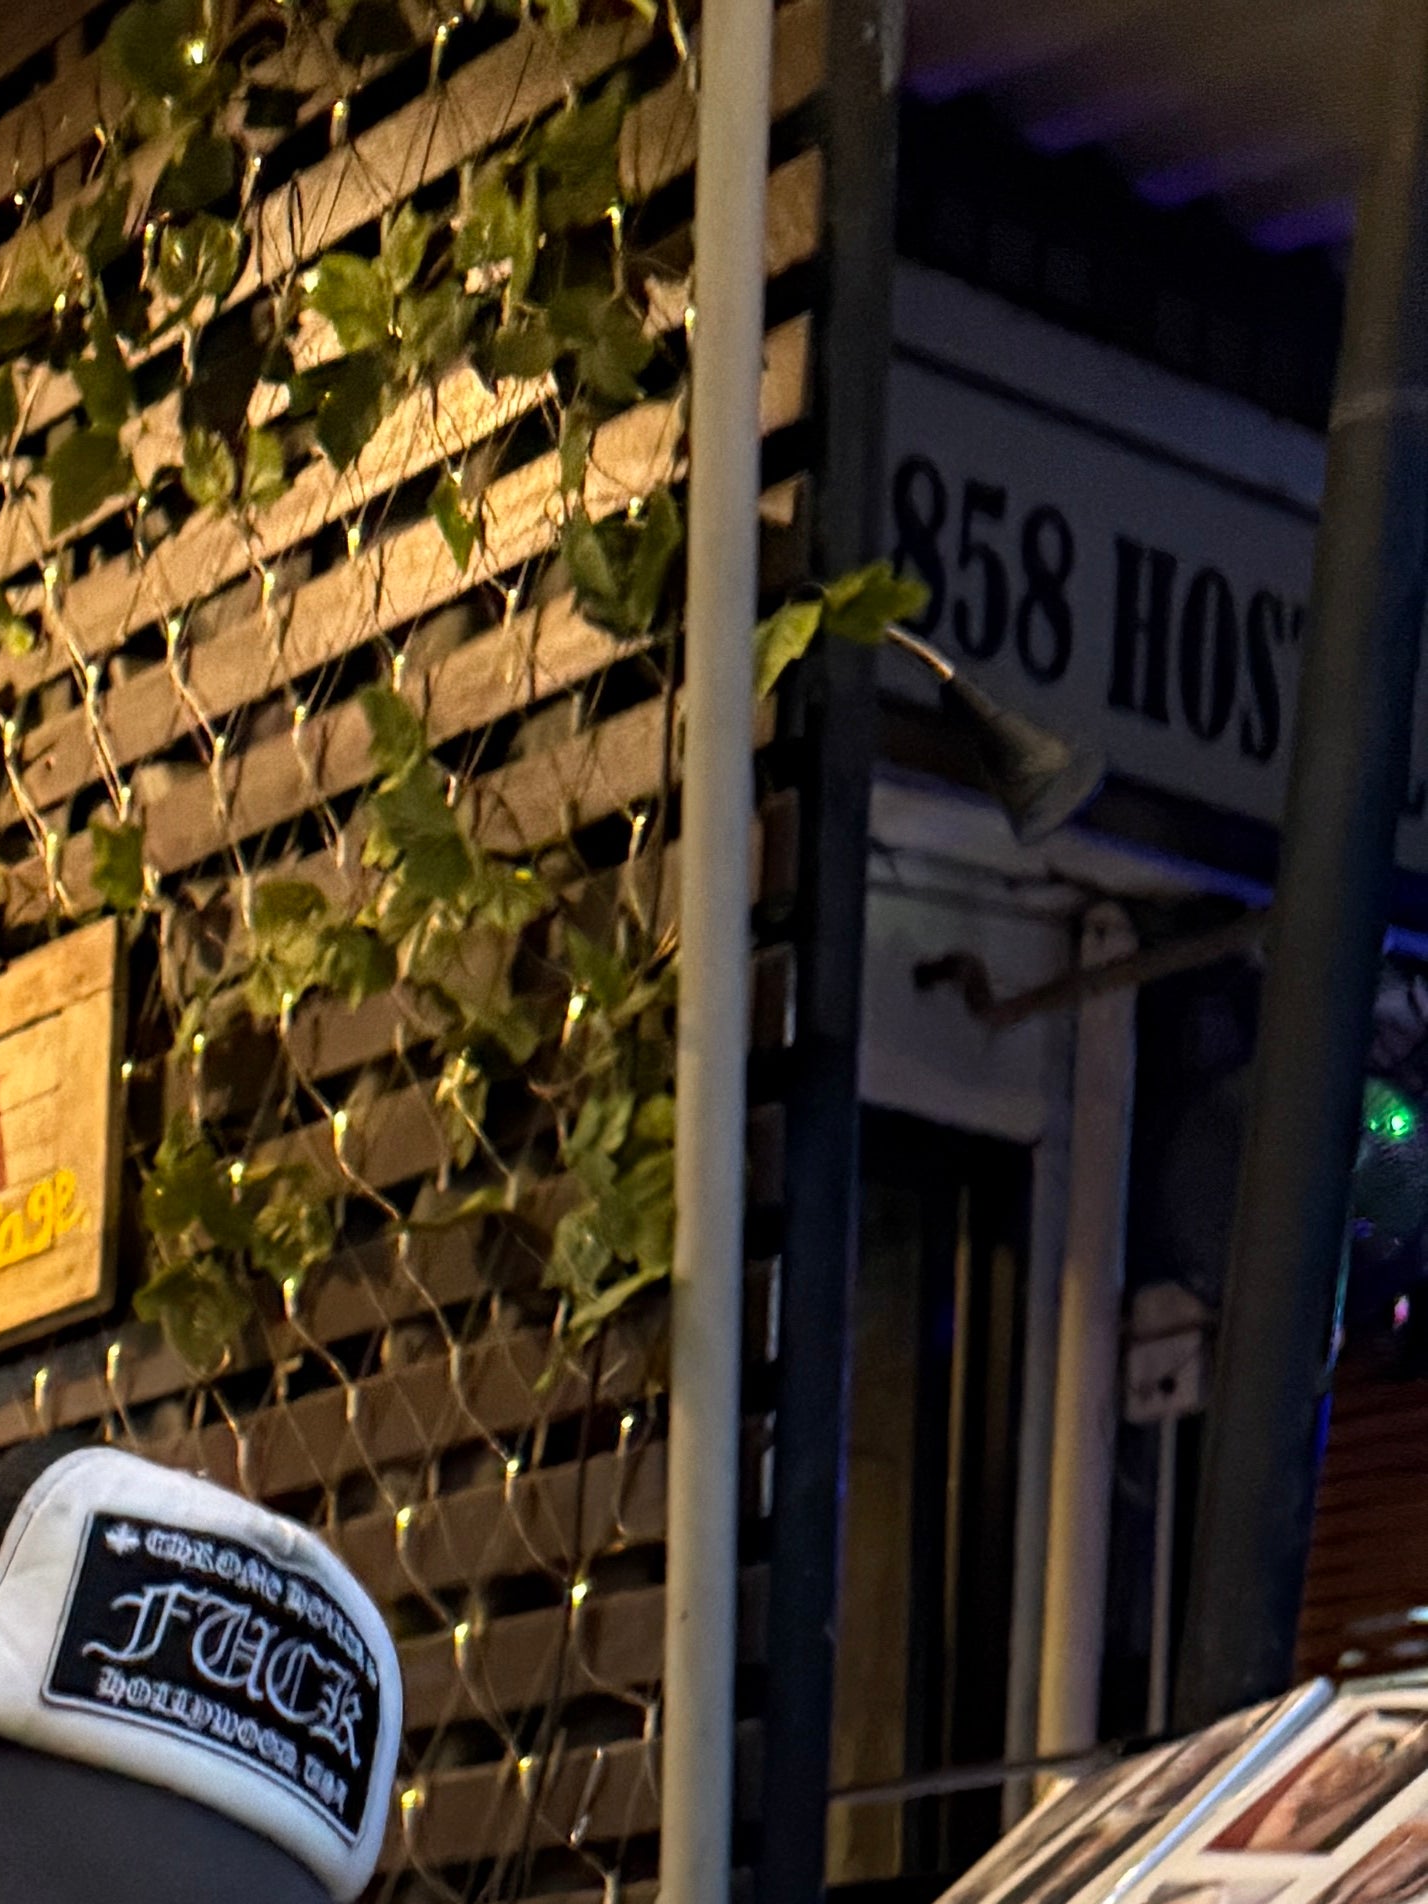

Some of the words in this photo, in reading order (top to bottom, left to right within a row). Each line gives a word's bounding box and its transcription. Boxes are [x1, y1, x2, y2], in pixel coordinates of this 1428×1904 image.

[892, 454, 1077, 684] 858
[1107, 532, 1302, 766] HOS
[144, 1528, 284, 1602] CHROME
[81, 1580, 365, 1770] FUCK
[96, 1664, 300, 1778] HOLLYWOOD
